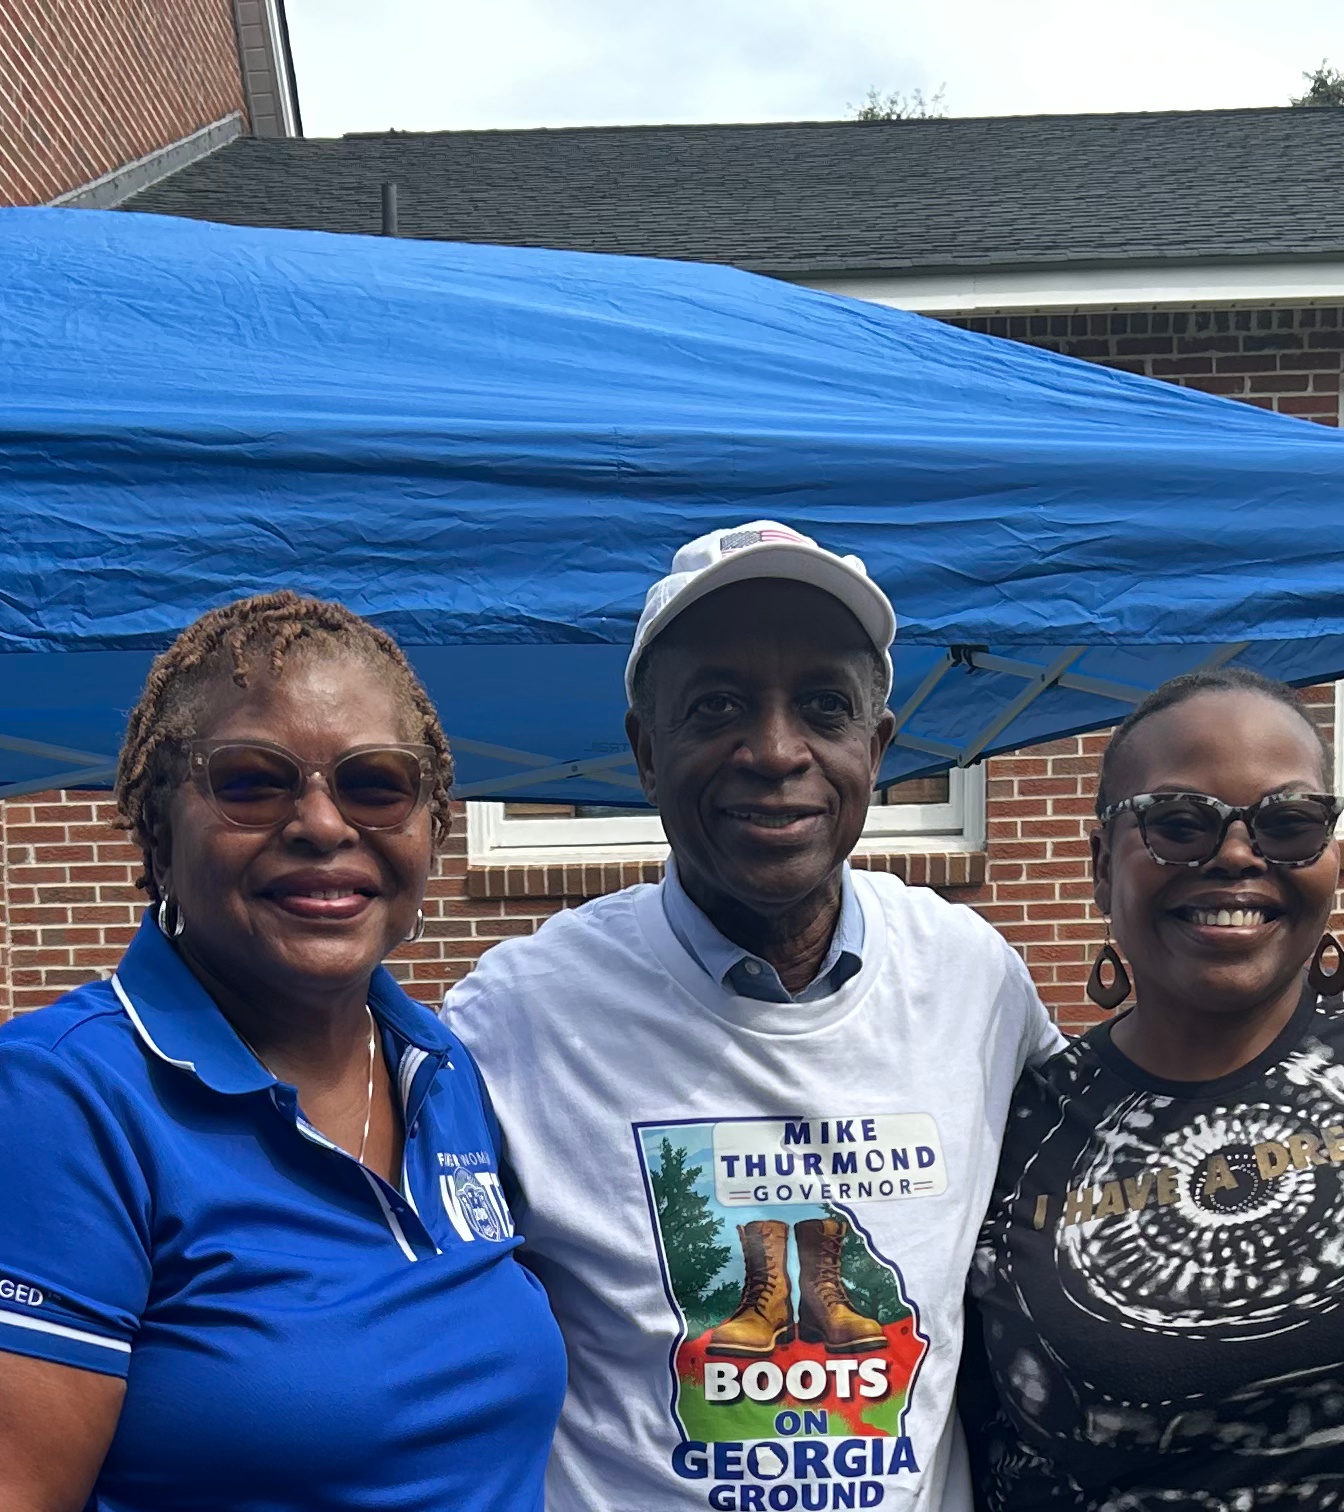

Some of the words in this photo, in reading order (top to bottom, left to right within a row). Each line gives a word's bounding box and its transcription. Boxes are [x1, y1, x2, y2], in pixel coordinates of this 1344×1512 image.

[783, 1118, 878, 1147] MIKE
[721, 1145, 936, 1178] THURMOND
[753, 1178, 912, 1202] GOVERNOR
[1032, 1194, 1048, 1231] I
[1065, 1166, 1183, 1227] HAVE
[1203, 1155, 1238, 1196] A
[703, 1357, 889, 1401] BOOTS
[774, 1409, 829, 1436] ON
[671, 1435, 920, 1481] GEORGIA
[708, 1480, 885, 1512] GROUND
